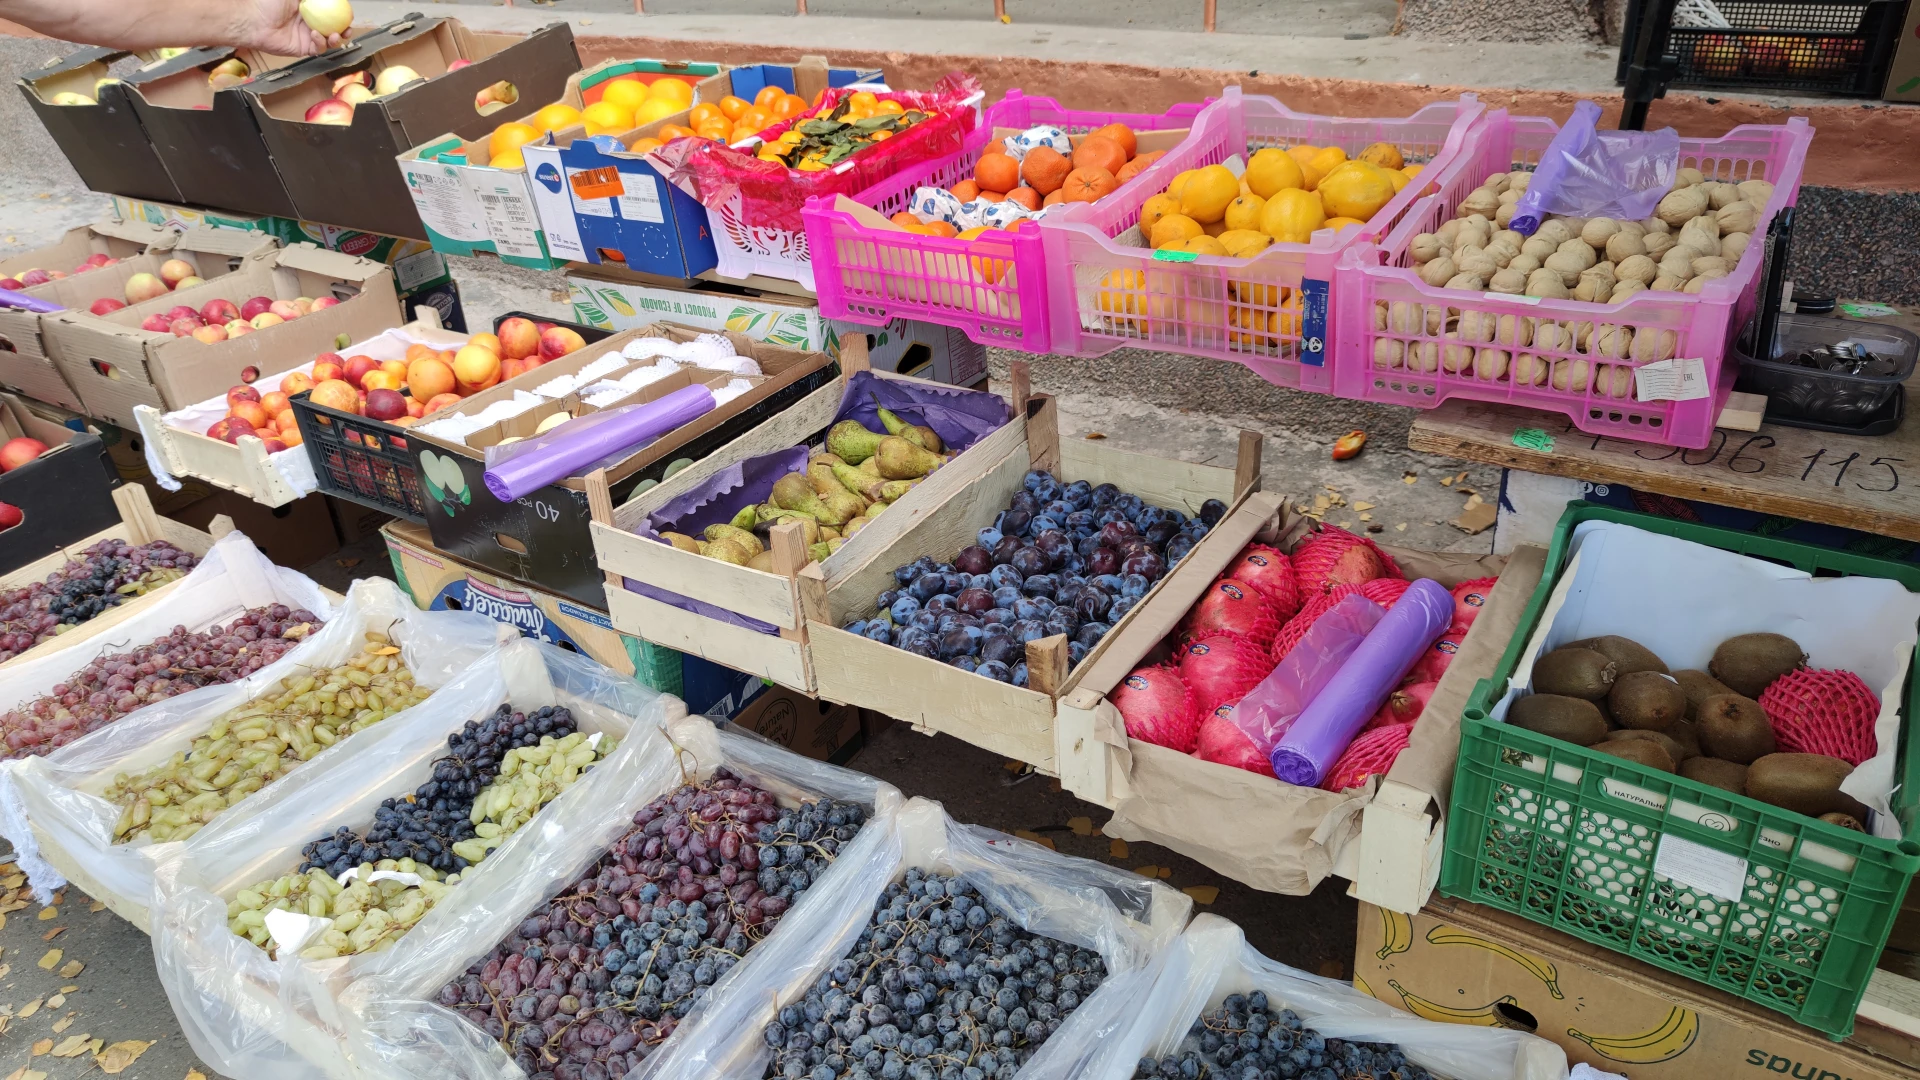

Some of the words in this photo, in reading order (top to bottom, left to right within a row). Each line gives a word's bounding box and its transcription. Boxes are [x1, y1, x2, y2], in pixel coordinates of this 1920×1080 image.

[639, 296, 671, 312] ECUADOR
[673, 302, 682, 314] OF
[684, 304, 717, 319] PRODUCT
[1801, 448, 1905, 492] 115
[535, 501, 560, 522] 40
[759, 704, 790, 735] Nature
[1745, 1049, 1855, 1080] anas
